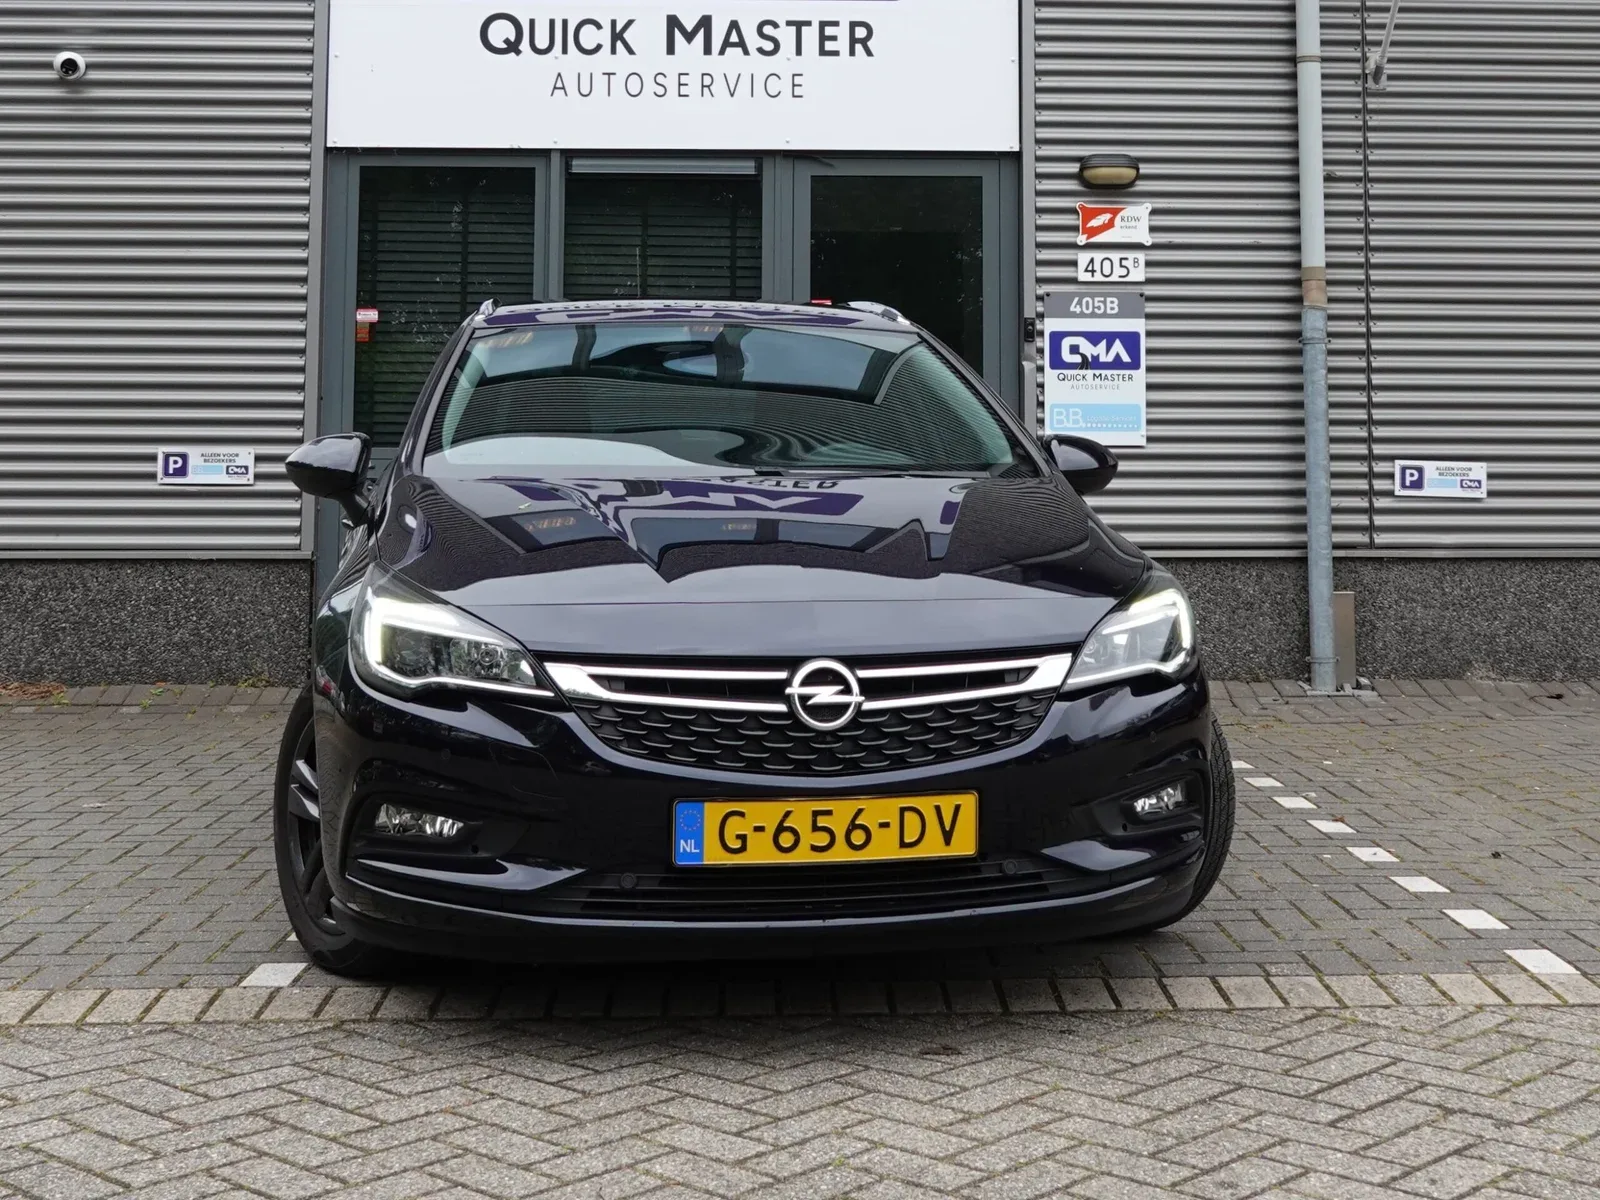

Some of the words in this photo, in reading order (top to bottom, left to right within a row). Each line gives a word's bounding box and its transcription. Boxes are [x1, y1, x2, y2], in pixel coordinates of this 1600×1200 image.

[550, 71, 804, 98] AUTOSERVICE
[1120, 215, 1142, 223] RDW
[1069, 296, 1119, 314] 405B
[1070, 383, 1120, 391] AUTOSERVICE
[168, 456, 183, 474] P
[1405, 468, 1419, 487] P
[717, 802, 963, 855] G-656-DV
[679, 839, 700, 853] NL
